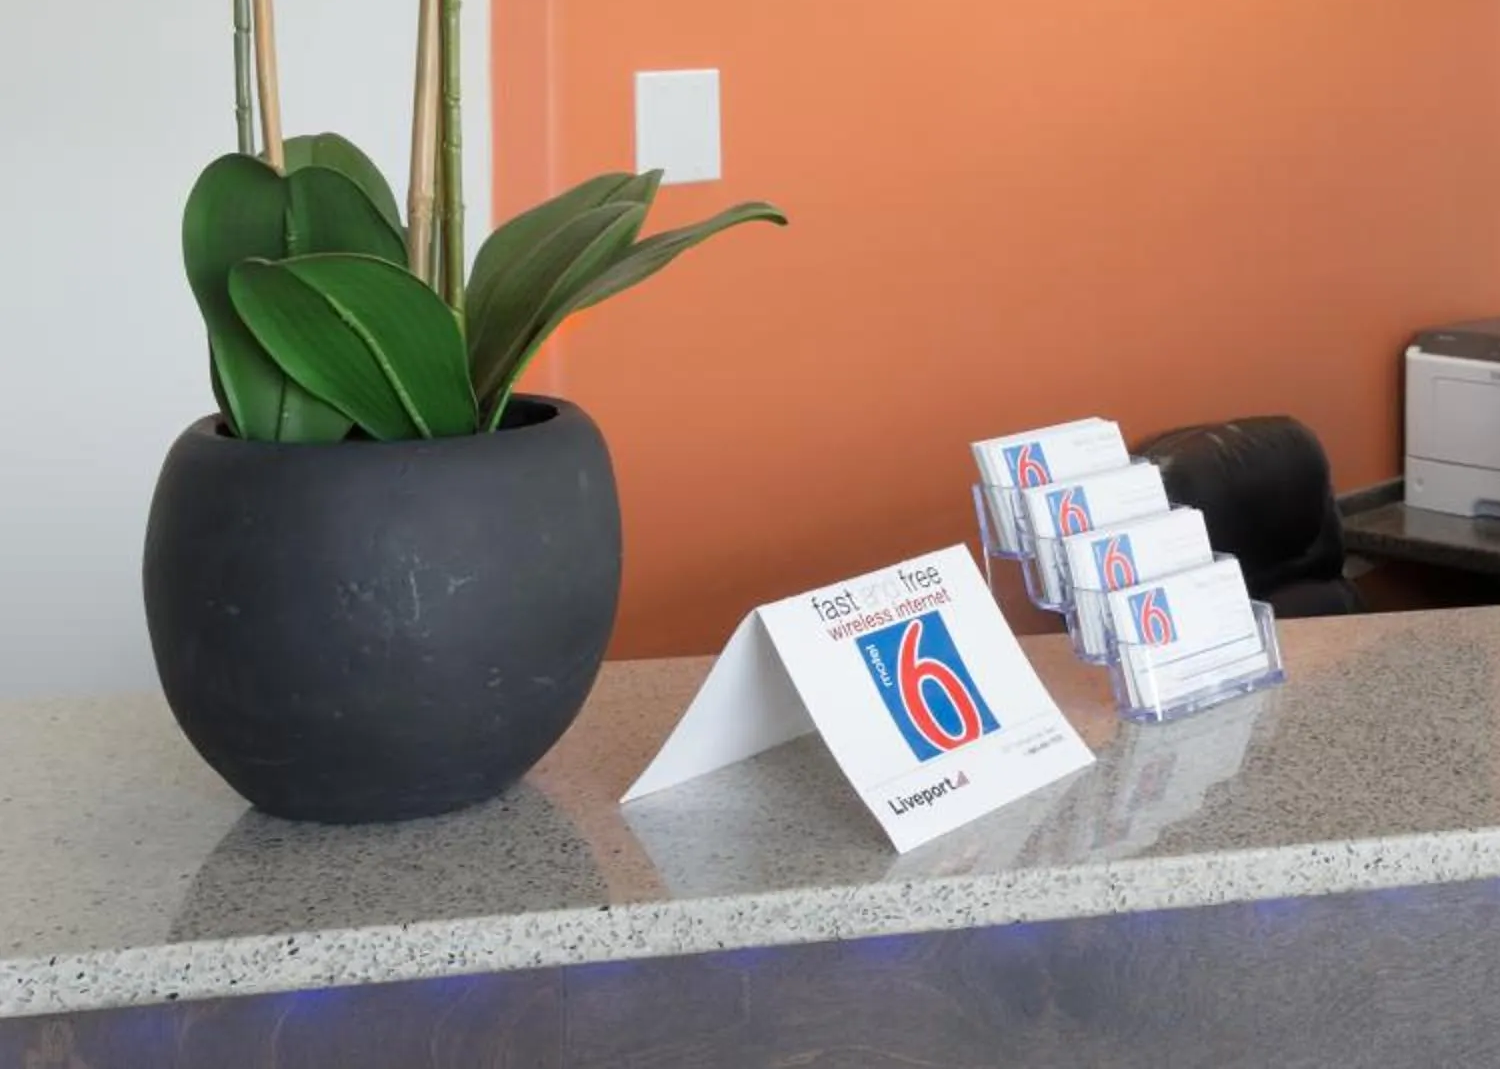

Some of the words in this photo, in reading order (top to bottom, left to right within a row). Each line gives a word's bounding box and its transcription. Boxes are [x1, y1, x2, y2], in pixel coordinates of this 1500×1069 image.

[811, 588, 861, 622] fast
[898, 565, 944, 593] free
[828, 606, 894, 641] wireless
[896, 586, 952, 618] internet
[1140, 590, 1172, 647] 6
[897, 618, 983, 752] 6
[887, 776, 957, 816] Liveport
